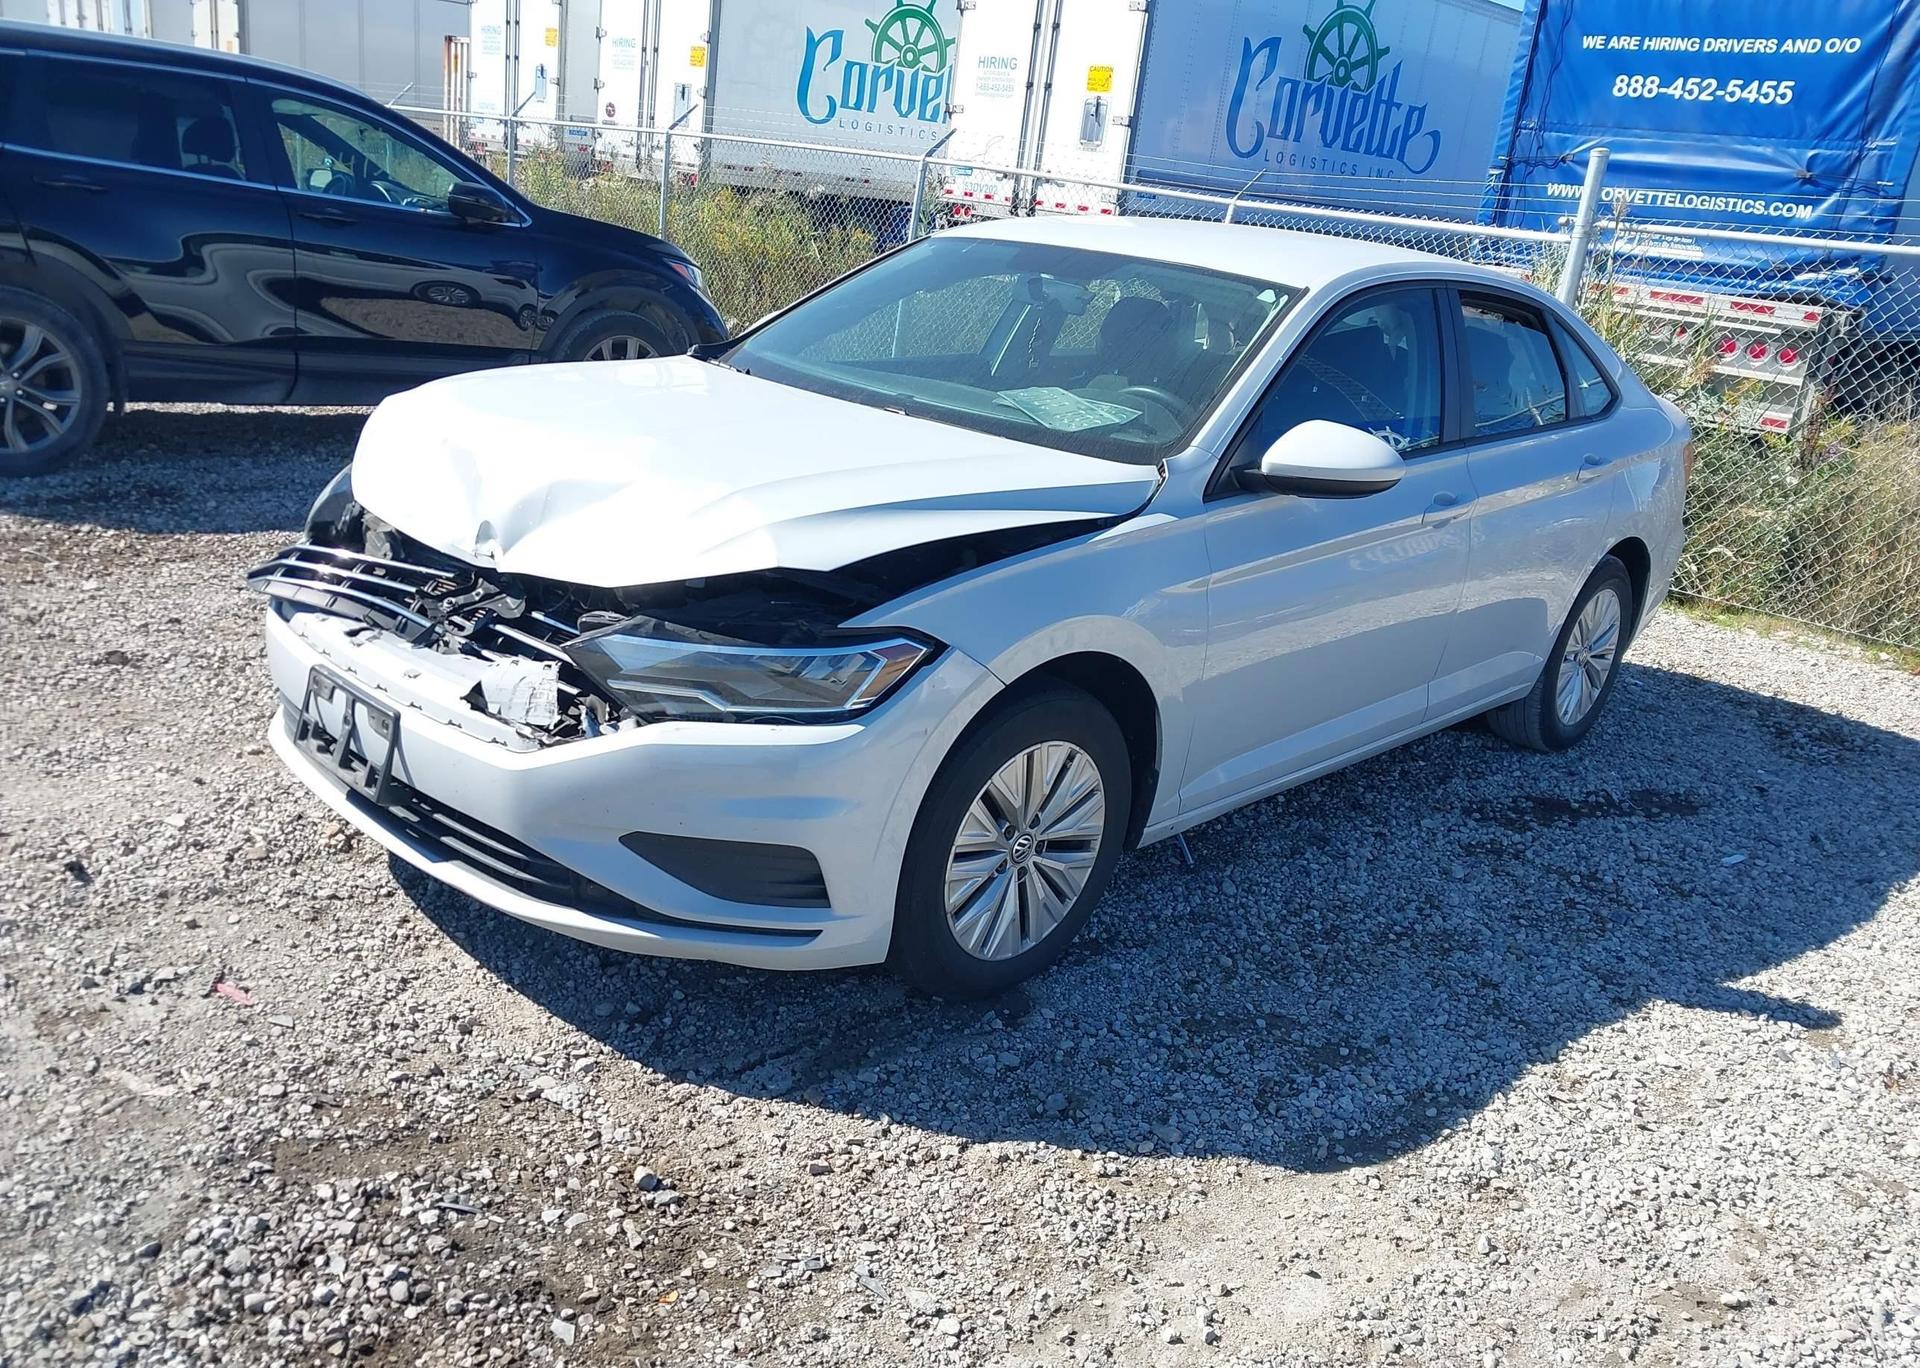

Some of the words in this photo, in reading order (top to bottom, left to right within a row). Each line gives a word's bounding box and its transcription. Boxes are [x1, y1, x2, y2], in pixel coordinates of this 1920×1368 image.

[1582, 35, 1607, 49] WE
[1607, 36, 1641, 50] ARE
[1642, 37, 1700, 52] HIRING
[1703, 38, 1778, 53] DRIVERS
[1780, 39, 1822, 53] AND
[1824, 38, 1862, 53] O/O
[977, 56, 1018, 70] HIRING
[1089, 65, 1114, 73] CAUTION
[1612, 74, 1796, 105] 888-452-5455
[1226, 36, 1441, 175] Corvette
[839, 118, 937, 141] LOGISTICS
[1264, 149, 1358, 177] LOGISTICS
